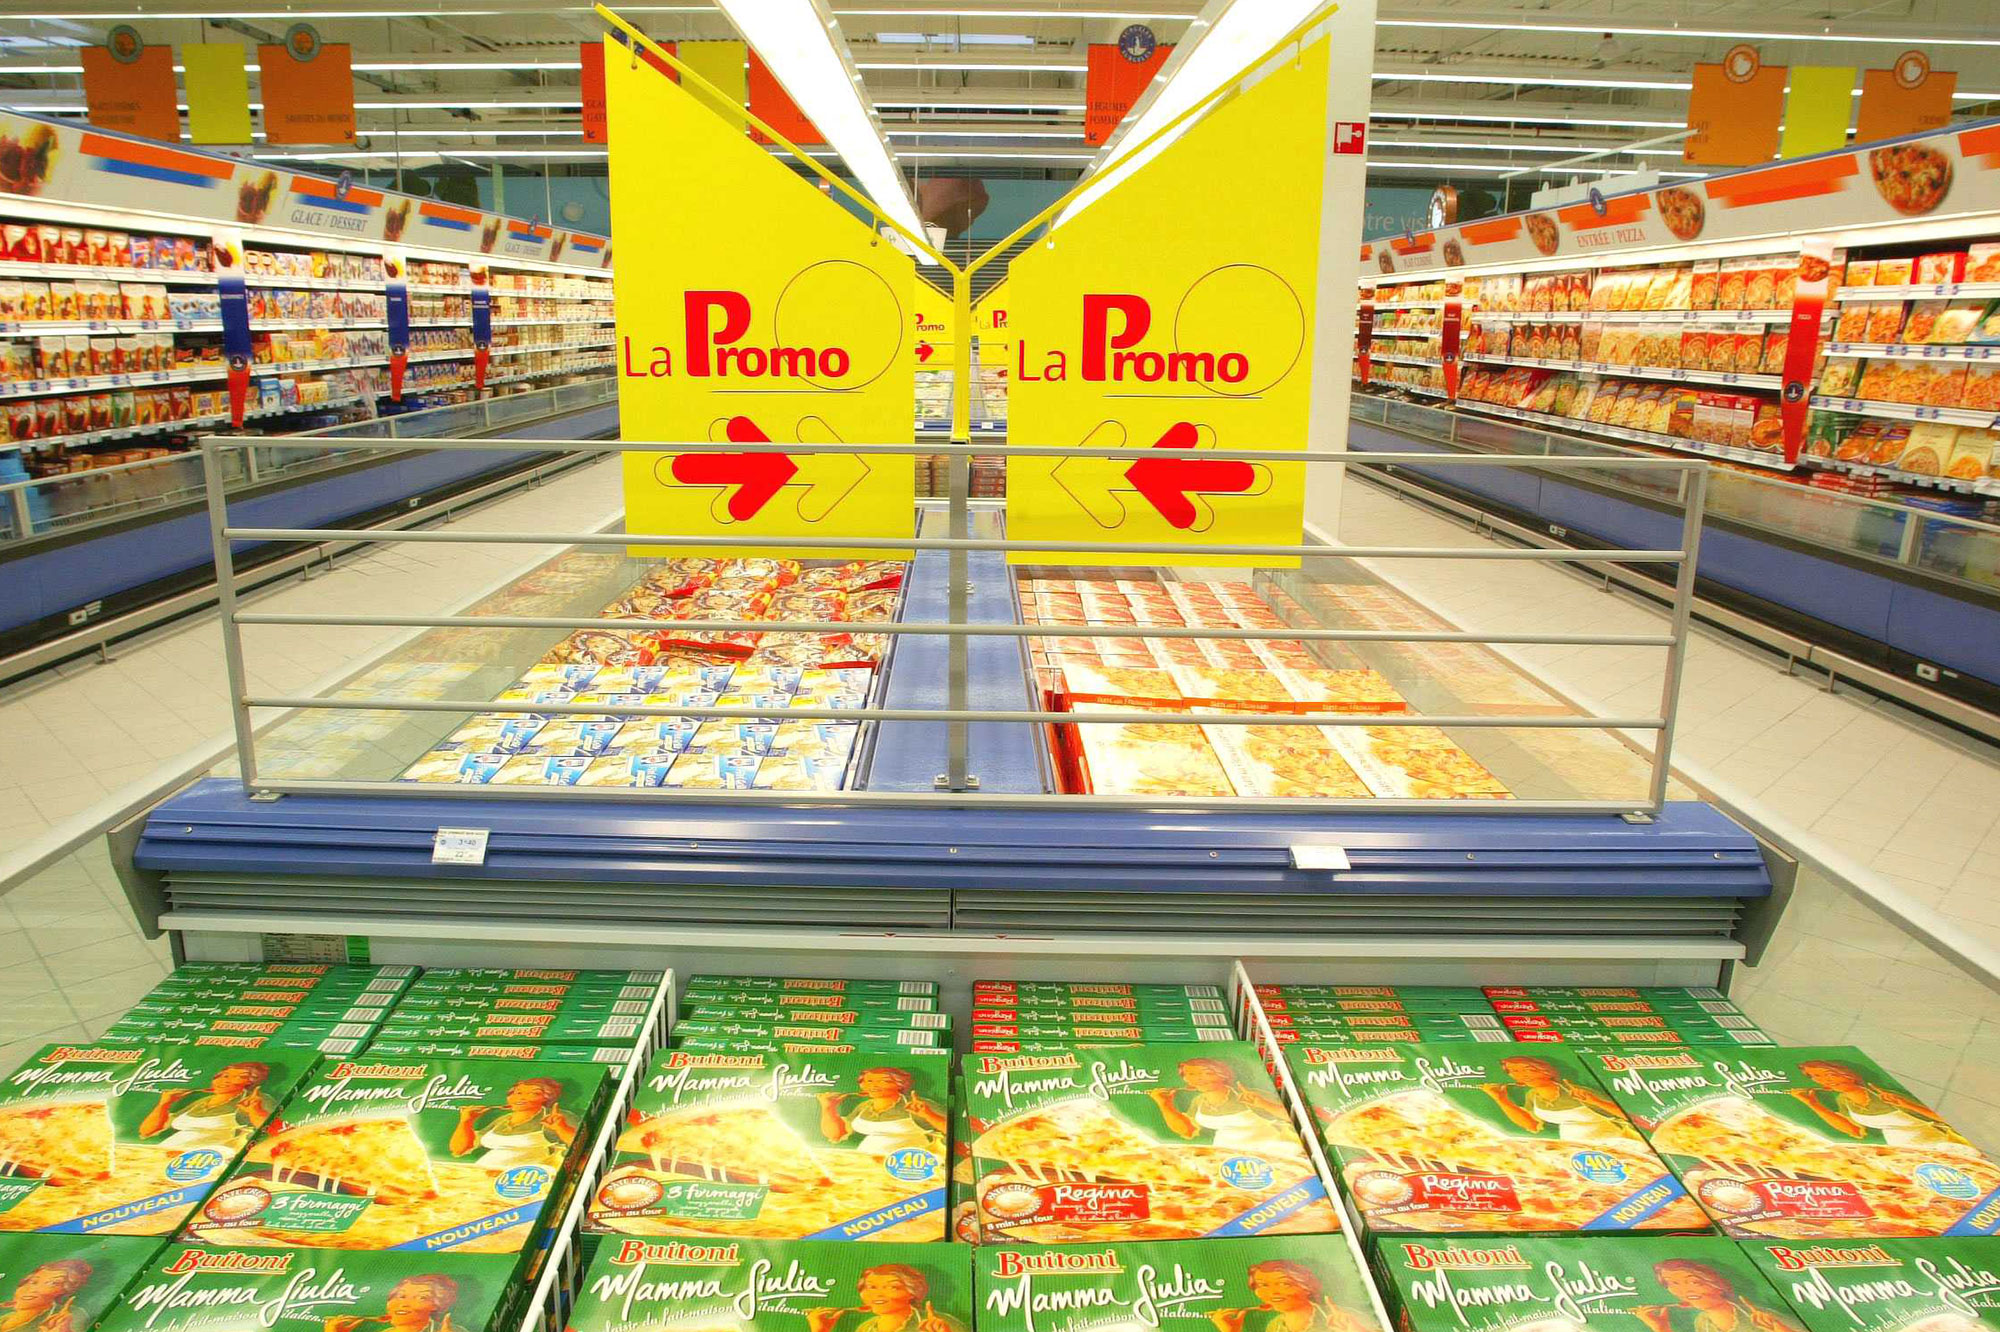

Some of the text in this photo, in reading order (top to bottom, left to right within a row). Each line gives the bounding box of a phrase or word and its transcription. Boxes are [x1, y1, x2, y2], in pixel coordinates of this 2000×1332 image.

[291, 209, 323, 225] GLACE
[329, 215, 368, 232] DESSERT
[1577, 231, 1609, 247] ENTRÉE
[1616, 228, 1646, 243] PIZZA
[624, 290, 850, 377] La Promo
[1018, 294, 1249, 382] La Promo
[42, 1046, 145, 1063] Buitoni
[661, 1051, 767, 1069] Buitoni
[977, 1053, 1081, 1074] Buitoni
[1303, 1046, 1405, 1065] Buitoni
[1599, 1052, 1704, 1072] Buitoni
[11, 1060, 117, 1096] Mamma
[325, 1062, 427, 1079] Buitoni
[648, 1066, 761, 1104] Mamma
[1308, 1060, 1417, 1099] Mamma
[303, 1077, 411, 1113] Mamma
[974, 1070, 1087, 1109] Mamma
[1613, 1068, 1722, 1106] Mamma
[667, 1183, 764, 1207] 3 formaggi
[1053, 1184, 1144, 1211] Regina
[1421, 1174, 1510, 1200] Regina
[1762, 1181, 1856, 1208] Regina
[82, 1192, 184, 1229] NOUVEAU
[271, 1193, 366, 1218] 3 formaggi
[602, 1210, 623, 1219] min.
[626, 1210, 640, 1218] au
[641, 1208, 663, 1217] four
[843, 1199, 929, 1236] NOUVEAU
[1242, 1189, 1311, 1230] NOUVEAU
[1611, 1184, 1673, 1224] NOUVEAU
[426, 1212, 520, 1249] NOUVEAU
[986, 1213, 1054, 1231] 8 min. au four
[162, 1249, 295, 1275] Buitoni
[609, 1238, 745, 1267] Buitoni
[991, 1249, 1127, 1278] Buitoni
[1401, 1243, 1533, 1271] Buitoni
[1765, 1244, 1904, 1272] Buitoni
[128, 1271, 265, 1329] Mamma
[590, 1261, 734, 1322] Mamma
[986, 1272, 1131, 1332] Mamma
[1411, 1267, 1550, 1328] Mamma
[1791, 1267, 1935, 1327] Mamma
[642, 1308, 658, 1326] du
